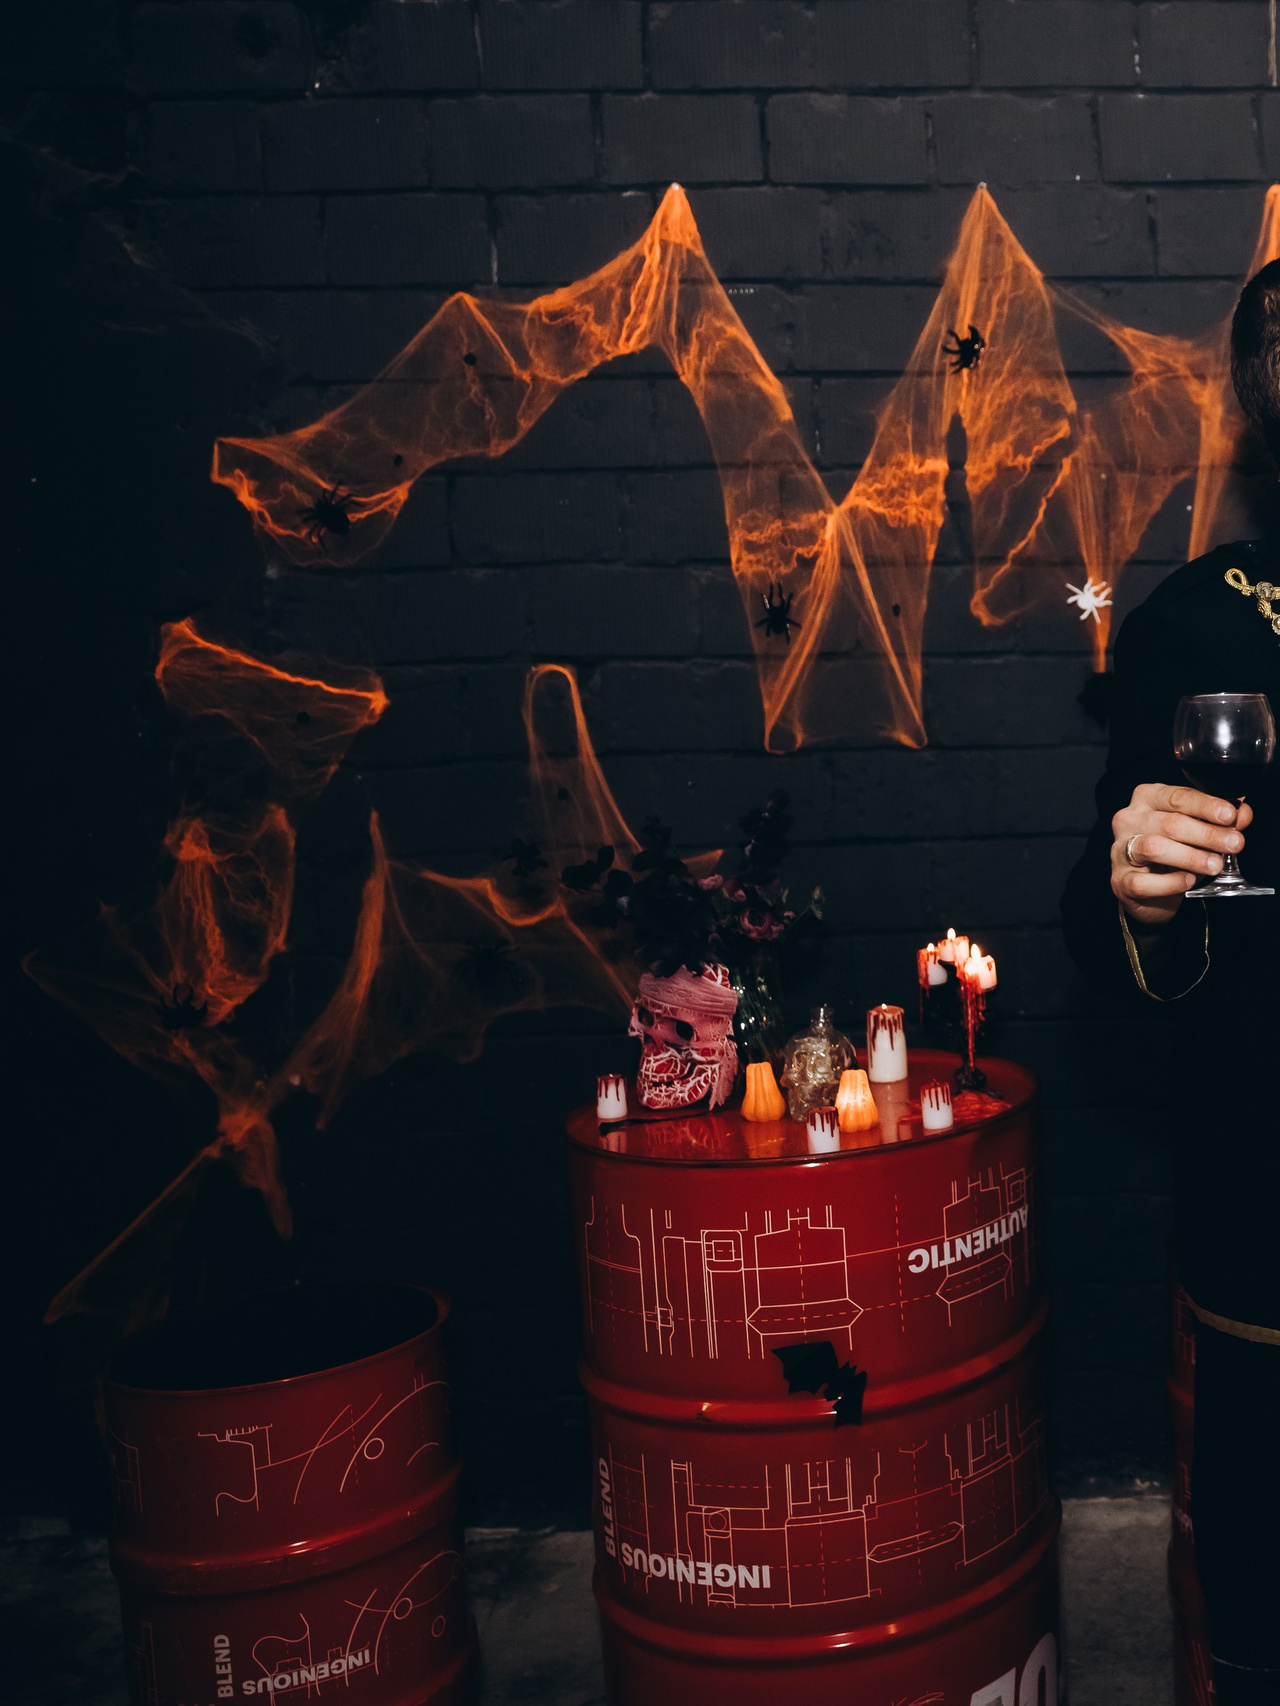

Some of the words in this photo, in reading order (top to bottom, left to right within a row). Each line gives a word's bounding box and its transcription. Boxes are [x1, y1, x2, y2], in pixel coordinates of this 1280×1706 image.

[907, 1204, 1029, 1274] AUTHENTIC
[599, 1457, 617, 1559] BLEND
[621, 1542, 772, 1589] INGENIOUS
[213, 1634, 234, 1698] BLEND
[242, 1649, 371, 1696] INGENIOUS
